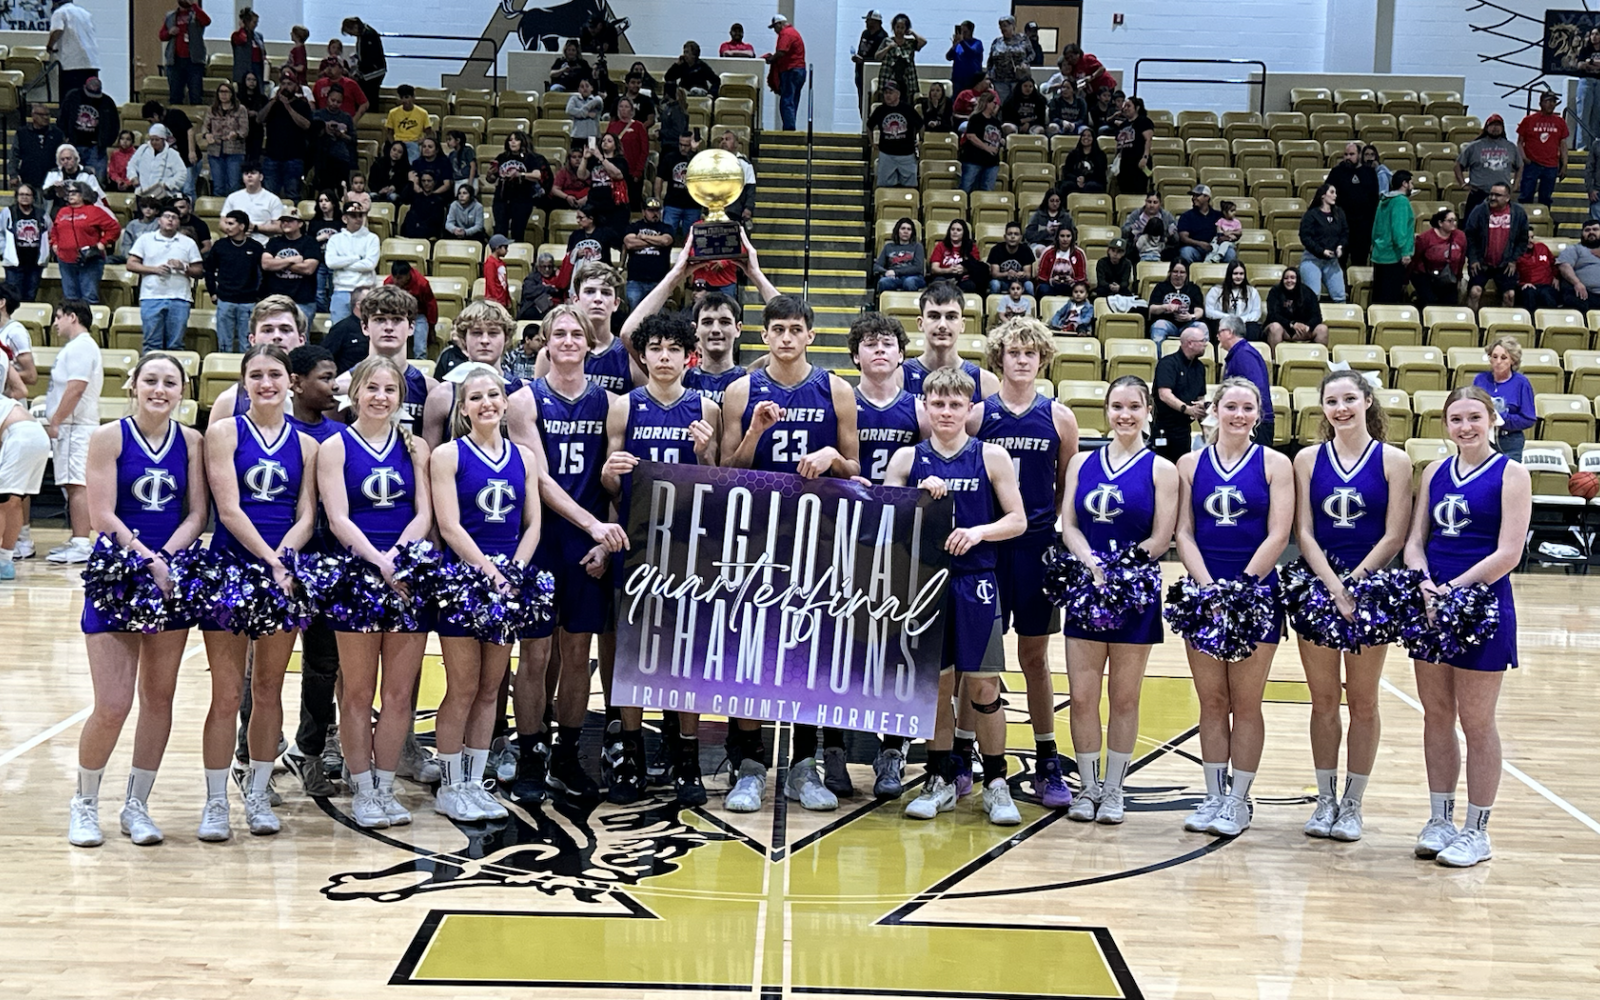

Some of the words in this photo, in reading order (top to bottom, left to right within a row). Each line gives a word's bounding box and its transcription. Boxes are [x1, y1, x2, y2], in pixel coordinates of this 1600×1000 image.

[543, 419, 603, 435] HORNETS
[779, 407, 825, 422] NETS
[772, 430, 808, 462] 23
[857, 428, 913, 443] ORNETS
[558, 442, 584, 474] 15
[1524, 454, 1562, 465] ANDREWS
[646, 480, 923, 605] REGIONAL
[625, 552, 949, 642] quarterfinal
[638, 592, 920, 701] CHAMPIONS
[632, 685, 696, 710] IRION
[712, 694, 801, 720] COUNTY
[817, 704, 919, 735] HORNETS
